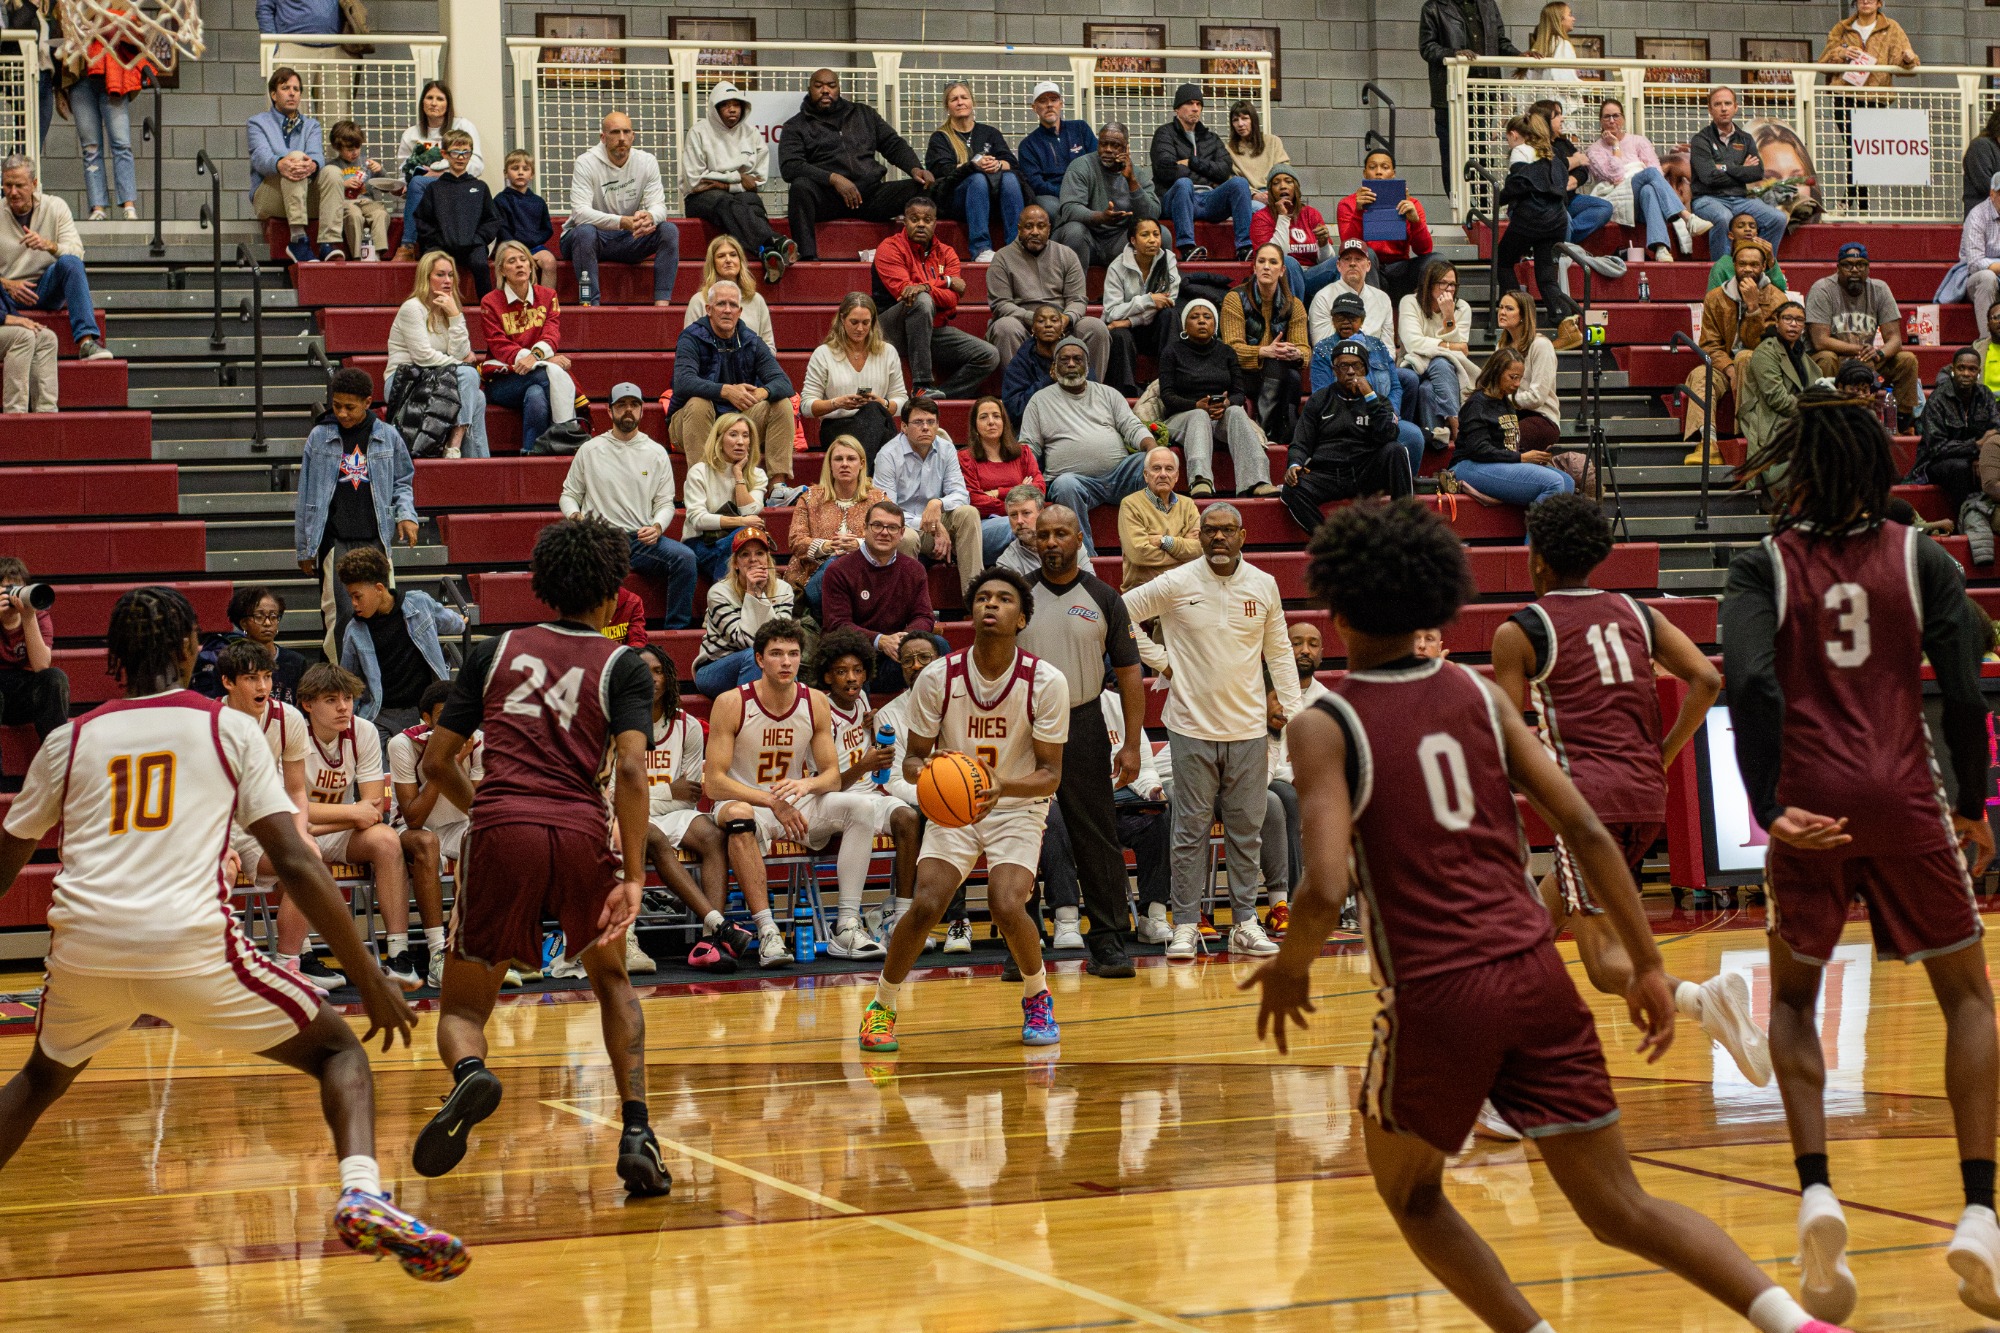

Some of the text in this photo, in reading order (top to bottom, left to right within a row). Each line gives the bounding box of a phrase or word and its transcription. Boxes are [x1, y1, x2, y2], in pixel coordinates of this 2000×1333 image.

[1854, 139, 1930, 156] VISITORS
[501, 305, 548, 335] BEARS
[1068, 607, 1099, 620] GHSA
[1824, 583, 1871, 668] 3
[1585, 622, 1635, 686] 11
[503, 653, 586, 733] 24
[762, 728, 794, 747] HIES
[842, 725, 864, 751] HIES
[967, 715, 1008, 739] HIES
[315, 768, 348, 790] HIES
[757, 750, 795, 785] 25
[961, 755, 985, 801] Wilson
[1417, 731, 1476, 832] 0
[107, 750, 177, 837] 10
